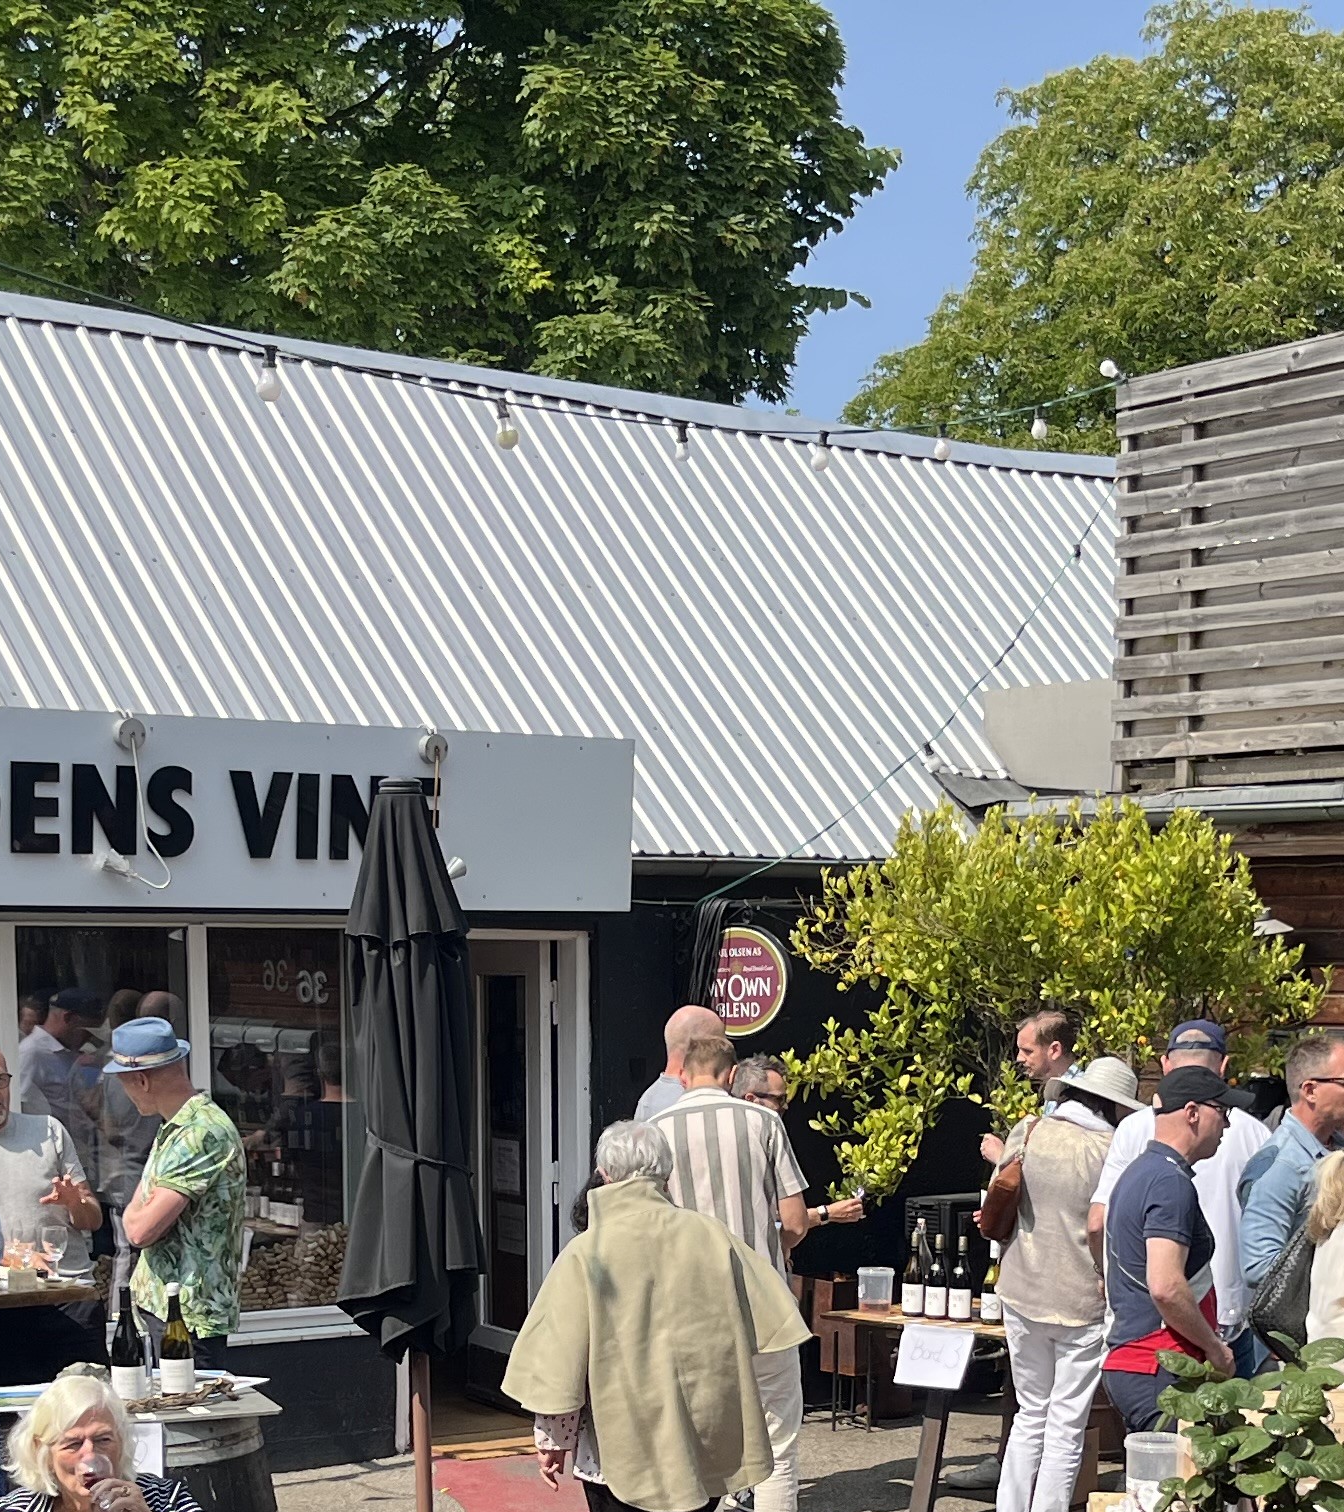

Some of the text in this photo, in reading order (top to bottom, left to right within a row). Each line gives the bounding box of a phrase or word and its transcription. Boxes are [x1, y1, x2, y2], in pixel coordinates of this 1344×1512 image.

[229, 769, 441, 861] VIN
[729, 947, 752, 957] OLSEN
[727, 974, 771, 1002] OWN
[716, 1002, 761, 1018] BLEND
